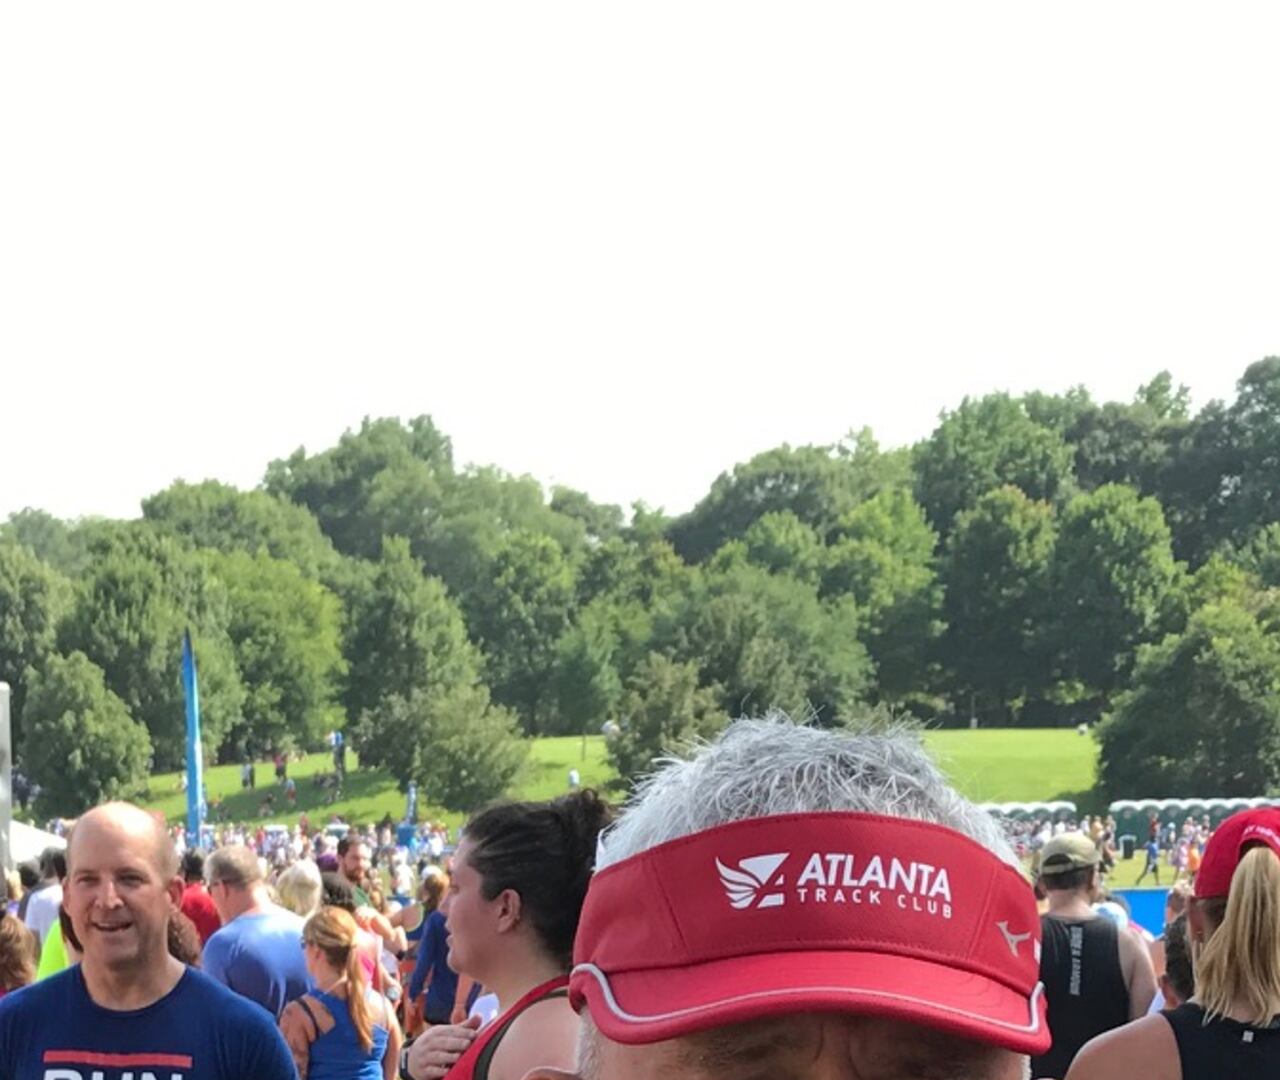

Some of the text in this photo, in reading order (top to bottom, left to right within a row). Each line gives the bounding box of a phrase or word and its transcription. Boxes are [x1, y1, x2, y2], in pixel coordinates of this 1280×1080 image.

[796, 852, 952, 903] ATLANTA
[797, 888, 952, 919] TRACK CLUB
